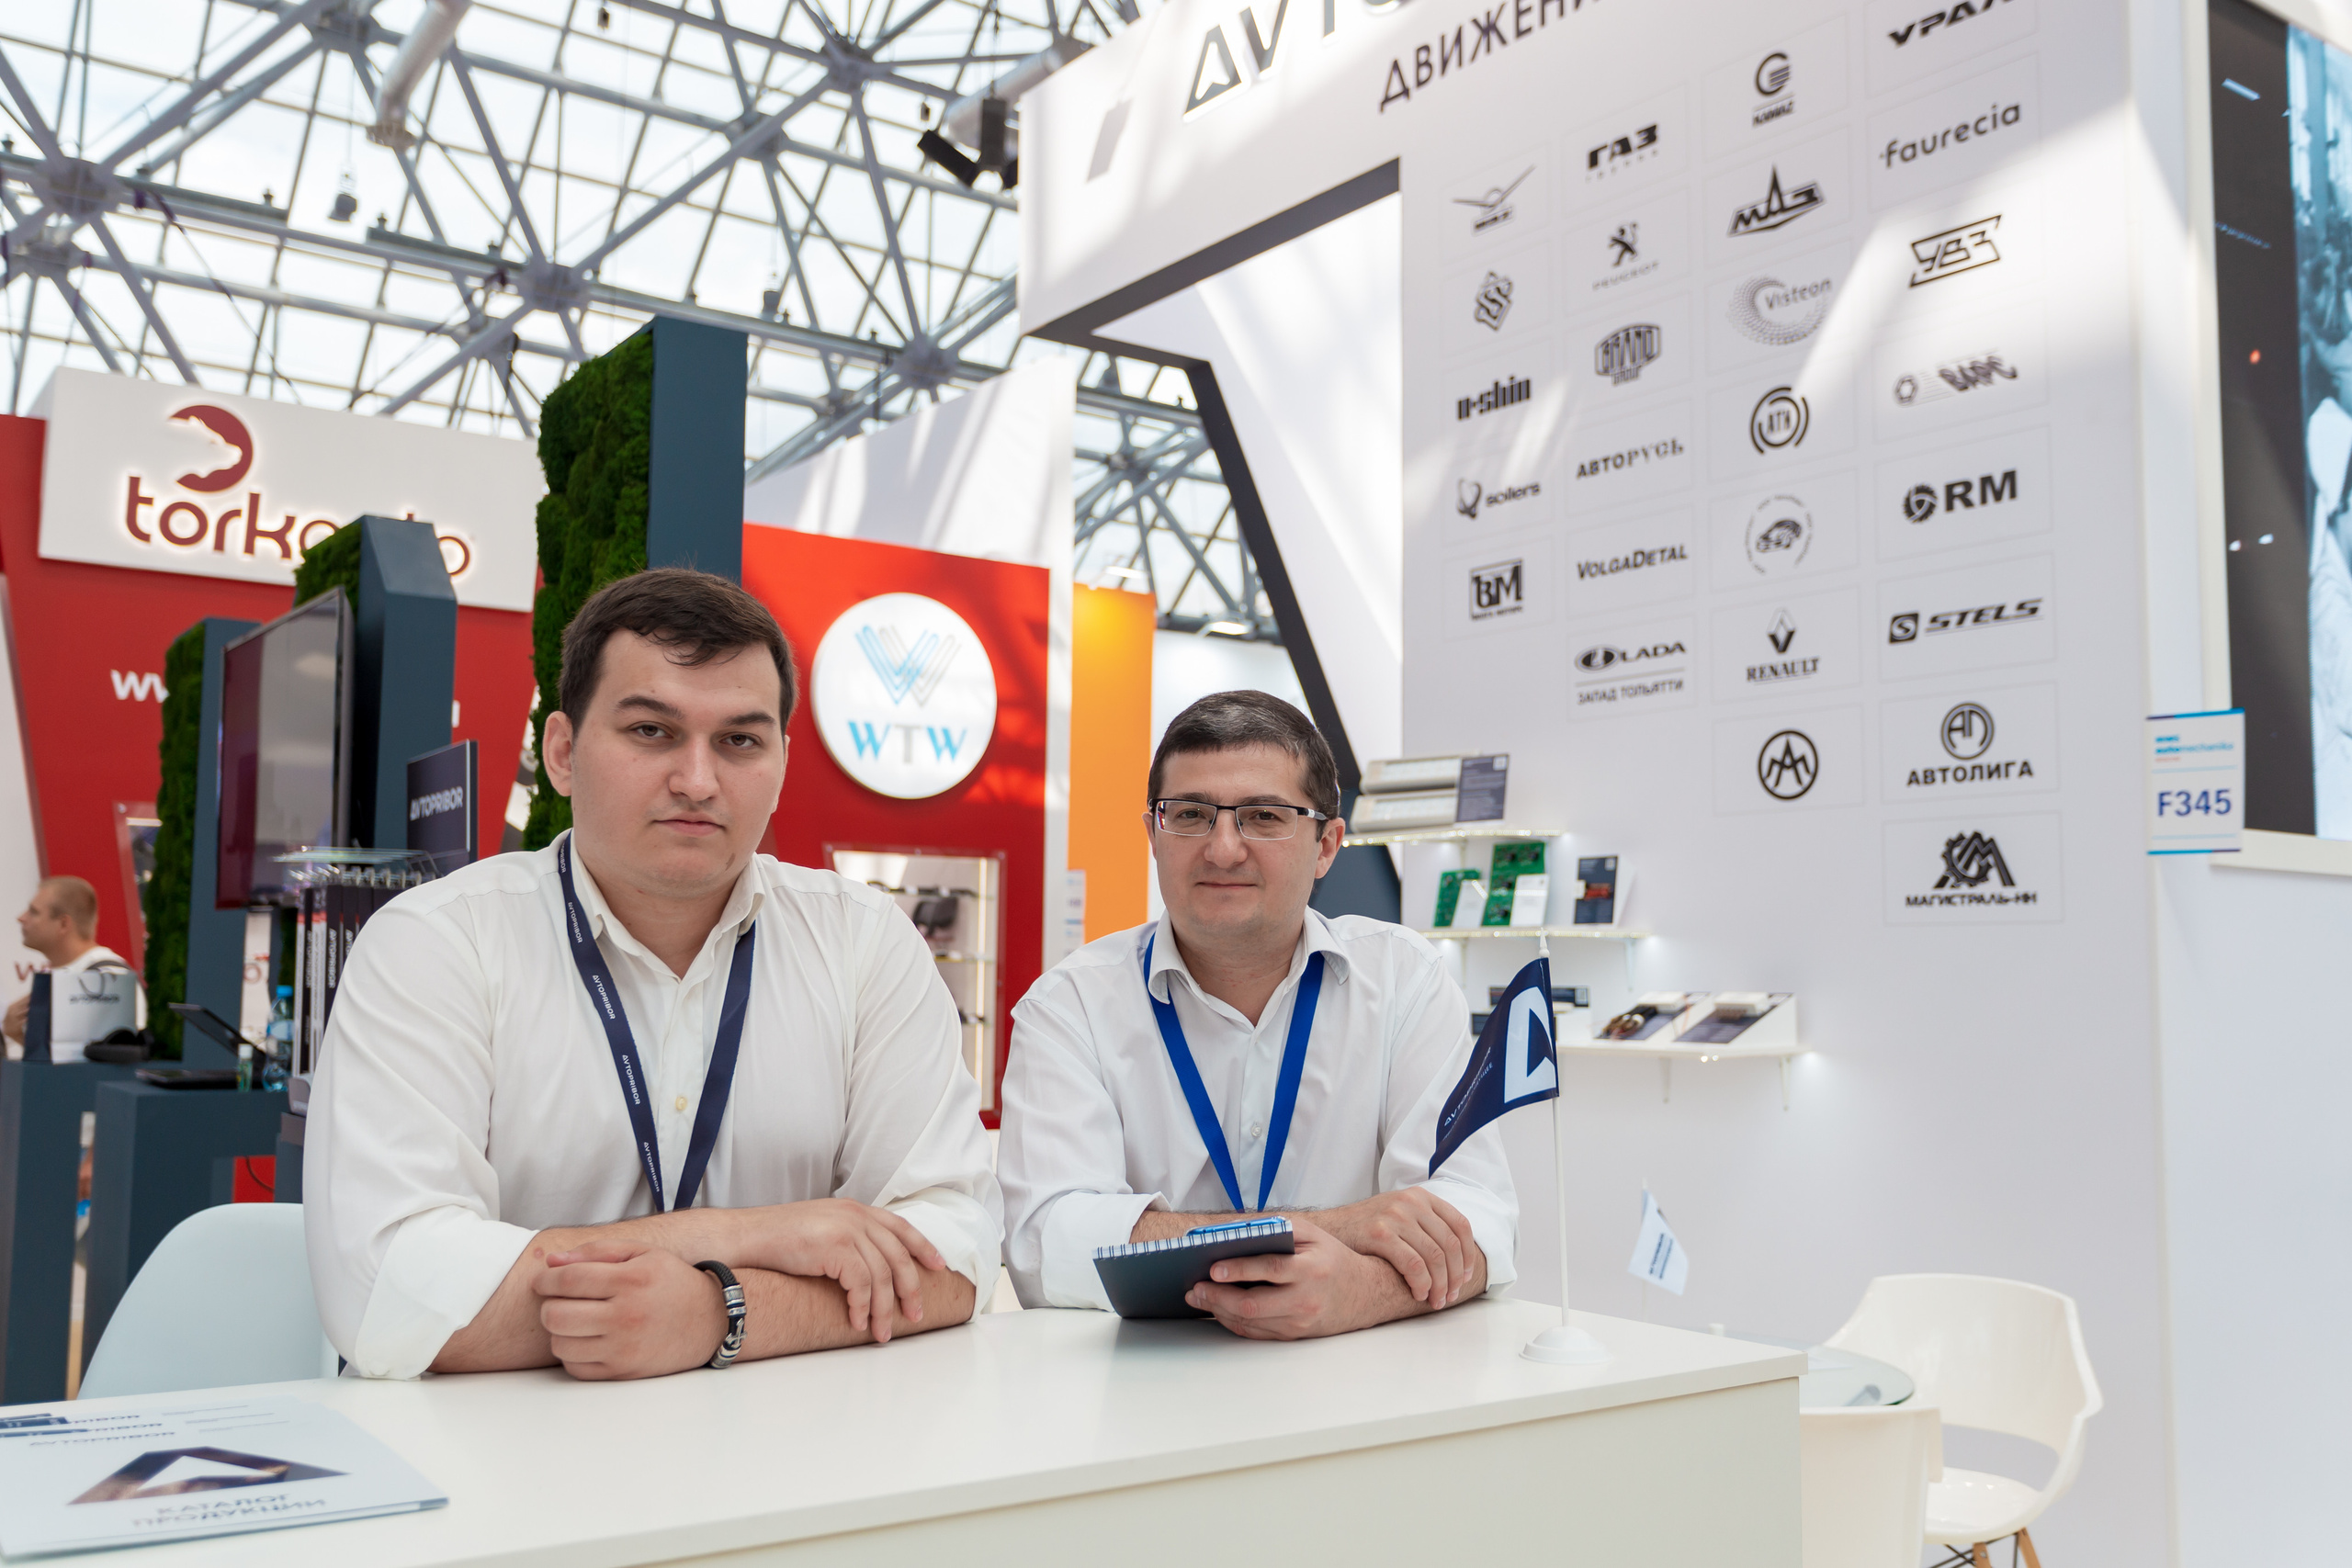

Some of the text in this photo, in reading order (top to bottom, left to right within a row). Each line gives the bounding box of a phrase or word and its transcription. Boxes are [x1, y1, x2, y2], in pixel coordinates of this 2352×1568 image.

[1183, 0, 1400, 116] AV
[1379, 0, 1602, 112] ДВИЖЕН
[1588, 123, 1659, 171] ГАЗ
[1881, 103, 2021, 169] faurecia
[1765, 277, 1833, 310] Visteon
[1576, 437, 1685, 480] АВТОРУСЬ
[1944, 468, 2018, 513] RM
[1924, 598, 2044, 633] STELS
[1620, 641, 1687, 663] LADA
[1747, 657, 1820, 682] RENAULT
[1577, 679, 1684, 705] ЗАПАД ТОЛЬЯТТИ
[846, 719, 968, 764] WTW
[1906, 759, 2035, 787] АВТОЛИГА
[409, 785, 464, 821] AVTOPRIBOR
[2156, 788, 2233, 818] F345
[568, 901, 584, 944] AVTOPRIBOR
[592, 974, 616, 1021] AVTOPRIBOR
[622, 1054, 640, 1105] AVTOPRIBOR
[643, 1141, 661, 1193] AVTOPRIBOR
[28, 1431, 175, 1447] AVTOPRIBOR
[131, 1498, 327, 1529] ПРОДУКЦИИ
[156, 1493, 290, 1515] КАТАЛОГ
